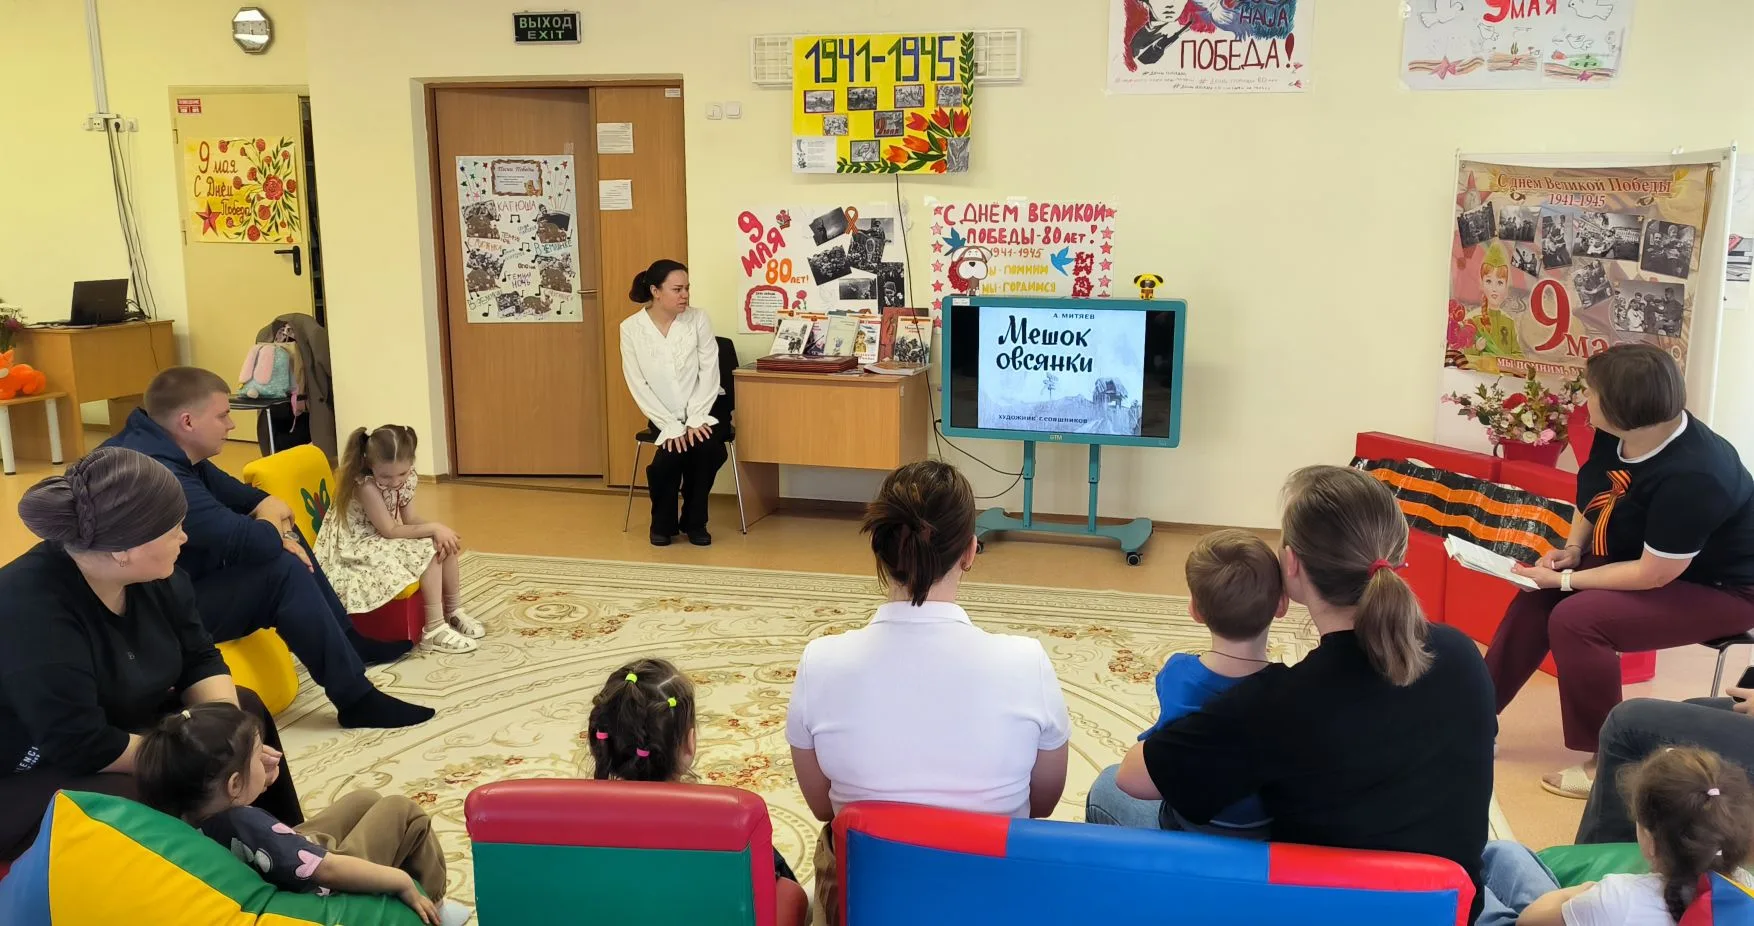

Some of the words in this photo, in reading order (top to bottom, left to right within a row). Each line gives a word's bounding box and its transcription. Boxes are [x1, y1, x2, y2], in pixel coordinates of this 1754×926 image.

[519, 16, 572, 29] ВЫХОД
[1510, 0, 1557, 20] МАЯ
[527, 30, 565, 39] EXIT
[804, 35, 956, 83] 1941-1945
[1180, 33, 1295, 71] ПОБЕДА!
[198, 140, 210, 174] 9
[193, 175, 202, 197] С
[1510, 176, 1542, 190] днём
[1544, 176, 1605, 192] Великой
[1608, 177, 1672, 195] Победы
[943, 204, 956, 226] С
[959, 201, 1019, 224] ДНЁМ
[1028, 201, 1107, 223] ВЕЛИКОЙ
[1549, 193, 1606, 207] 1941-1945
[738, 211, 764, 243] 9
[741, 226, 786, 277] МАЯ
[765, 258, 793, 285] 80
[998, 314, 1092, 348] Мешок
[1530, 279, 1571, 352] 9
[1564, 333, 1623, 359] ма
[996, 346, 1094, 373] овсянки
